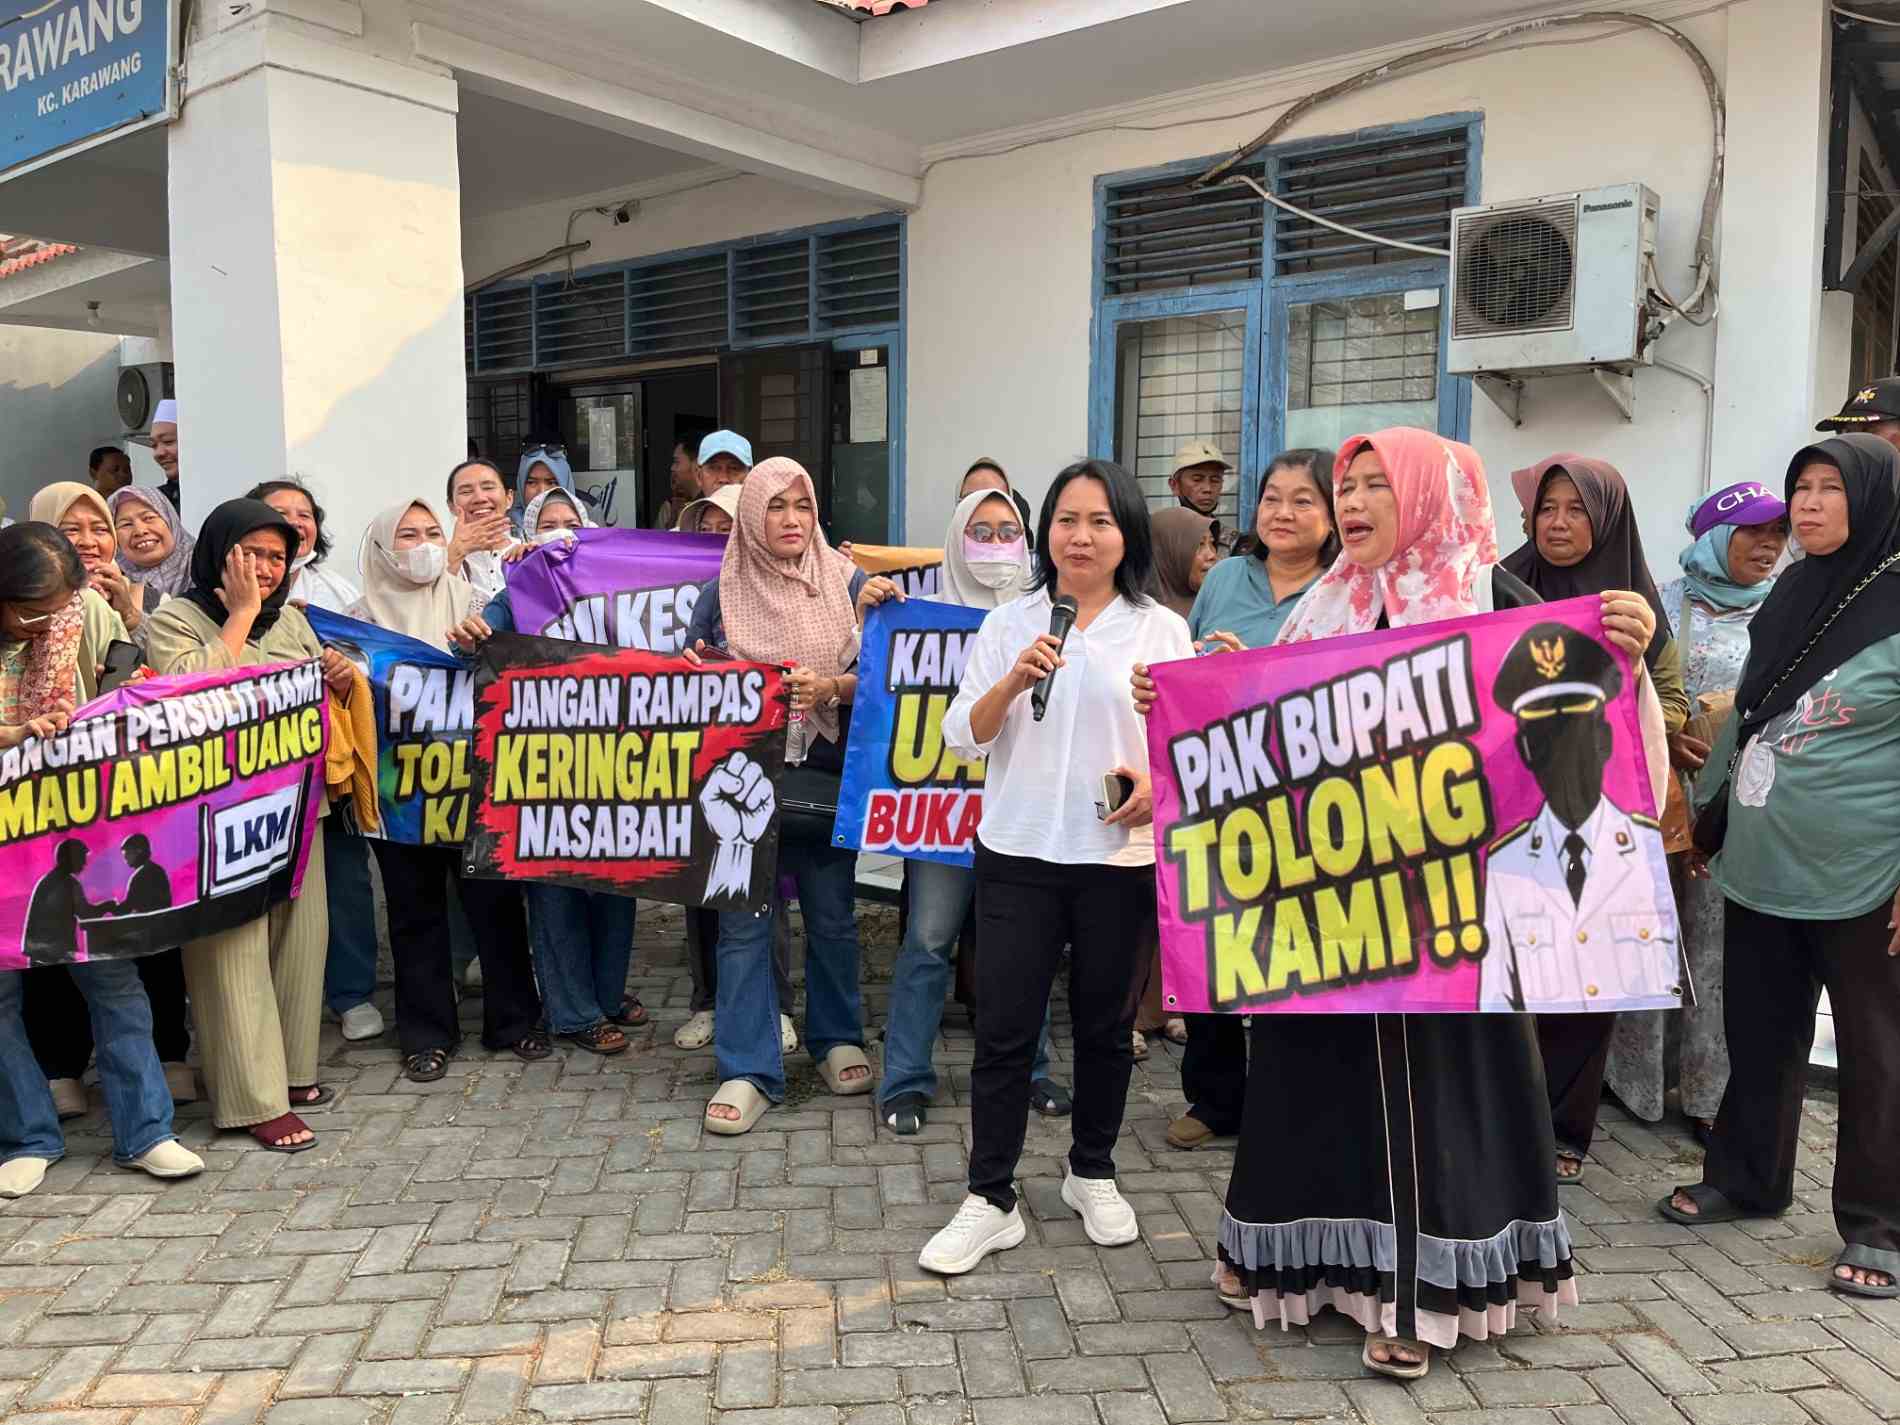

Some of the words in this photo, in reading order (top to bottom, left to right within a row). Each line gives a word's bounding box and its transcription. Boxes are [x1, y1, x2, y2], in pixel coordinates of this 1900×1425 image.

[38, 93, 59, 116] KC.
[62, 51, 142, 106] KARAWANG
[1583, 199, 1633, 213] Panasonic
[127, 680, 261, 752] PERSULIT
[261, 661, 323, 715] KAMI
[504, 676, 620, 728] JANGAN
[628, 671, 764, 725] RAMPAS
[1173, 709, 1279, 815] PAK
[1280, 640, 1474, 779] BUPATI
[0, 768, 96, 842] MAU
[110, 736, 231, 817] AMBIL
[236, 707, 323, 776] UANG
[493, 731, 701, 803] KERINGAT
[224, 805, 292, 864] LKM
[518, 804, 692, 858] NASABAH
[1172, 741, 1487, 912] TOLONG
[1214, 871, 1413, 1003] KAMI
[1423, 853, 1483, 958] !!
